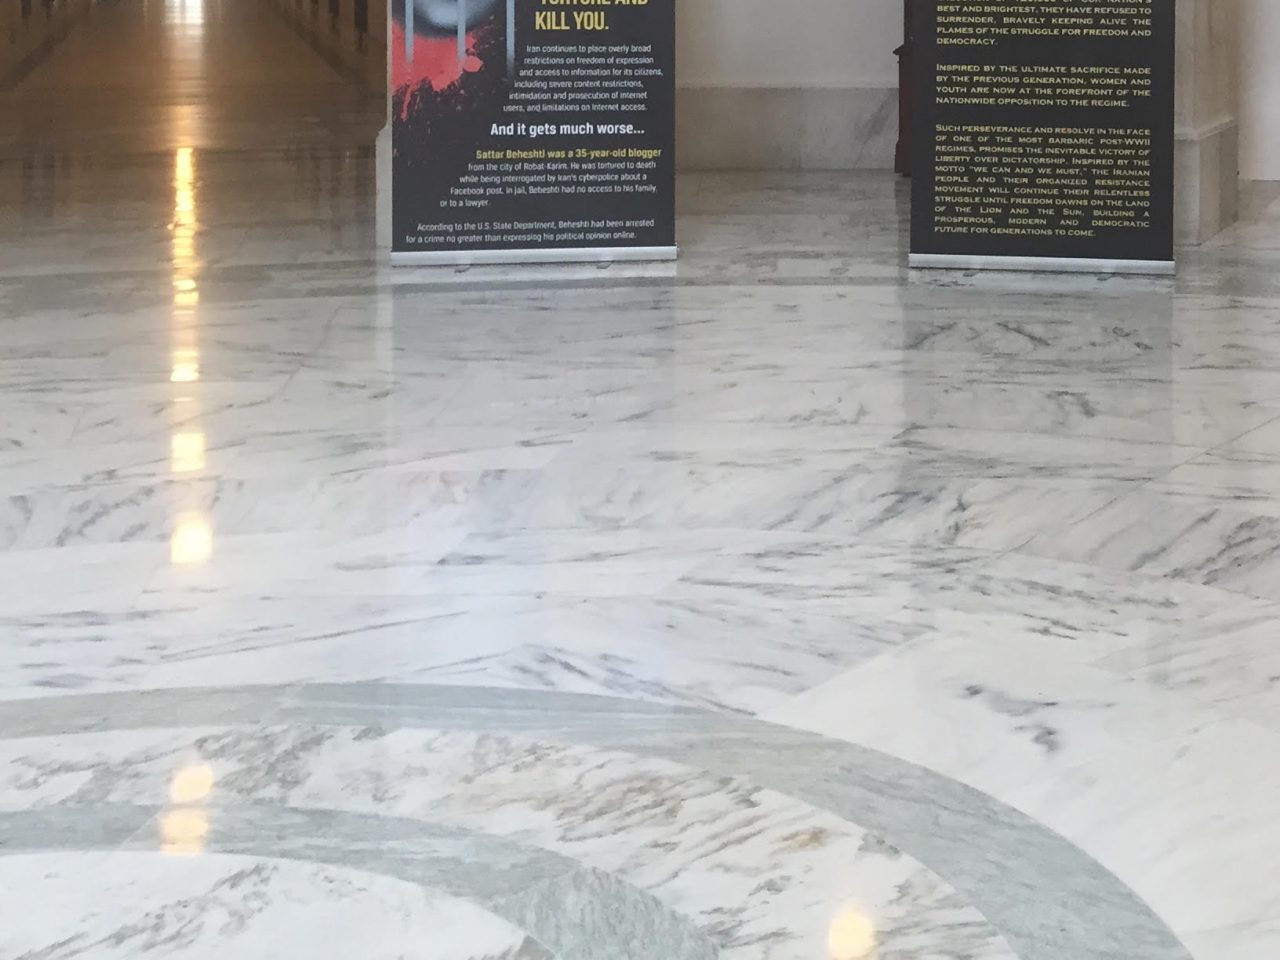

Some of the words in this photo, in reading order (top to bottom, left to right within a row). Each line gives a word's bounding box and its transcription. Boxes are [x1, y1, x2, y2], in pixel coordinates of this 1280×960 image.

[937, 5, 960, 13] BEST
[1040, 6, 1064, 14] THEY
[1066, 6, 1092, 14] HAVE
[535, 12, 570, 30] KILL
[574, 12, 609, 30] YOU.
[1052, 17, 1093, 25] KEEPING
[1062, 28, 1081, 36] FOR
[524, 57, 564, 65] restrictions
[566, 57, 575, 65] on
[577, 57, 605, 65] freedom
[607, 57, 614, 65] of
[616, 57, 654, 65] expression
[936, 64, 980, 72] INSPIRED
[1000, 65, 1017, 73] THE
[1021, 65, 1067, 73] ULTIMATE
[1070, 66, 1120, 74] SACRIFICE
[1124, 67, 1151, 75] MADE
[951, 75, 969, 83] THE
[1090, 77, 1127, 85] WOMEN
[491, 124, 513, 136] And
[518, 123, 526, 135] it
[529, 124, 556, 137] gets
[560, 122, 593, 134] much
[597, 124, 644, 134] worse...
[476, 150, 503, 159] Sattar
[547, 150, 565, 158] was
[576, 149, 626, 159] 35-year-old
[628, 148, 662, 159] blogger
